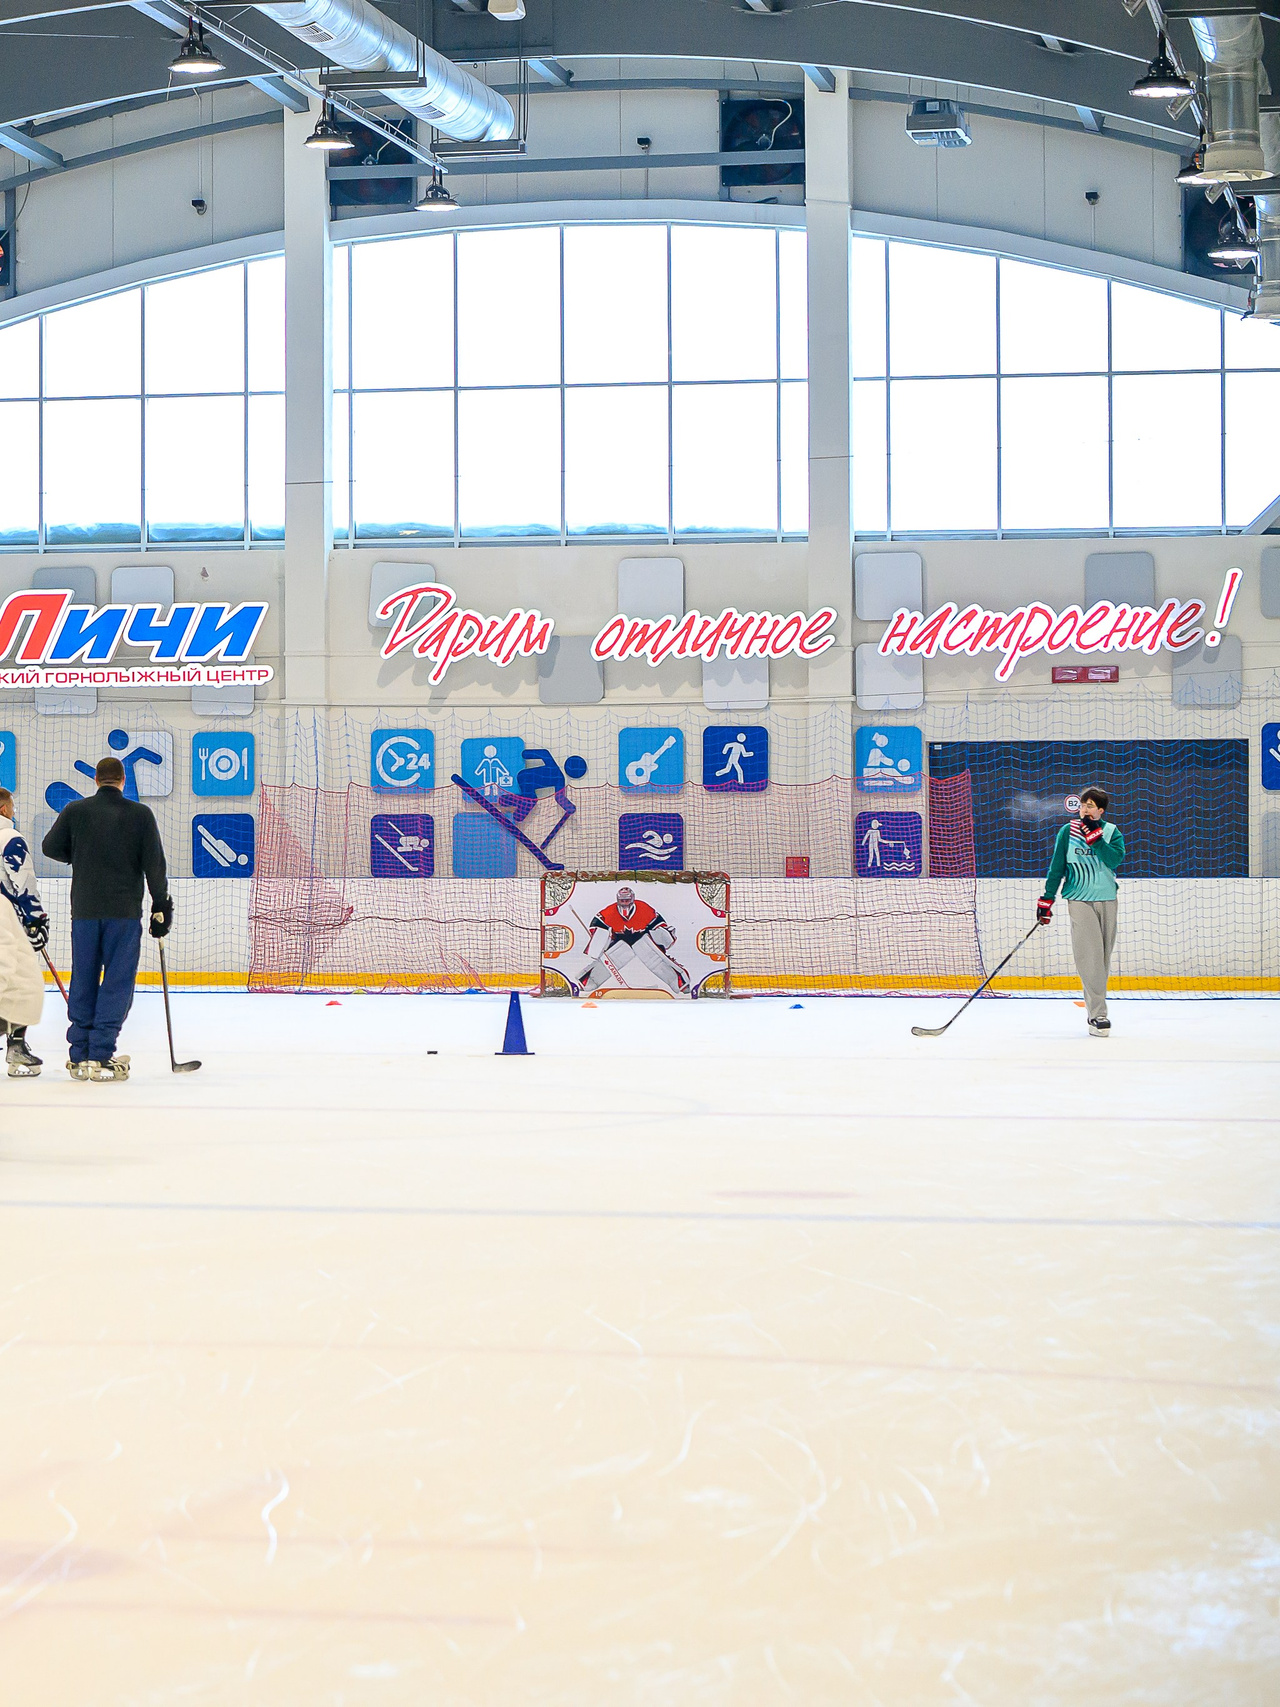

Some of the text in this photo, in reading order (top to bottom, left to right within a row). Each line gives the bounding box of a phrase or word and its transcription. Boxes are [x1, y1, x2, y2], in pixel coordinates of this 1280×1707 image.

[379, 571, 1241, 682] Дарим отличное настроение!
[45, 667, 202, 684] ГОРНОЛЫЖНЫЙ
[206, 669, 270, 684] ЦЕНТР
[406, 753, 431, 770] 24
